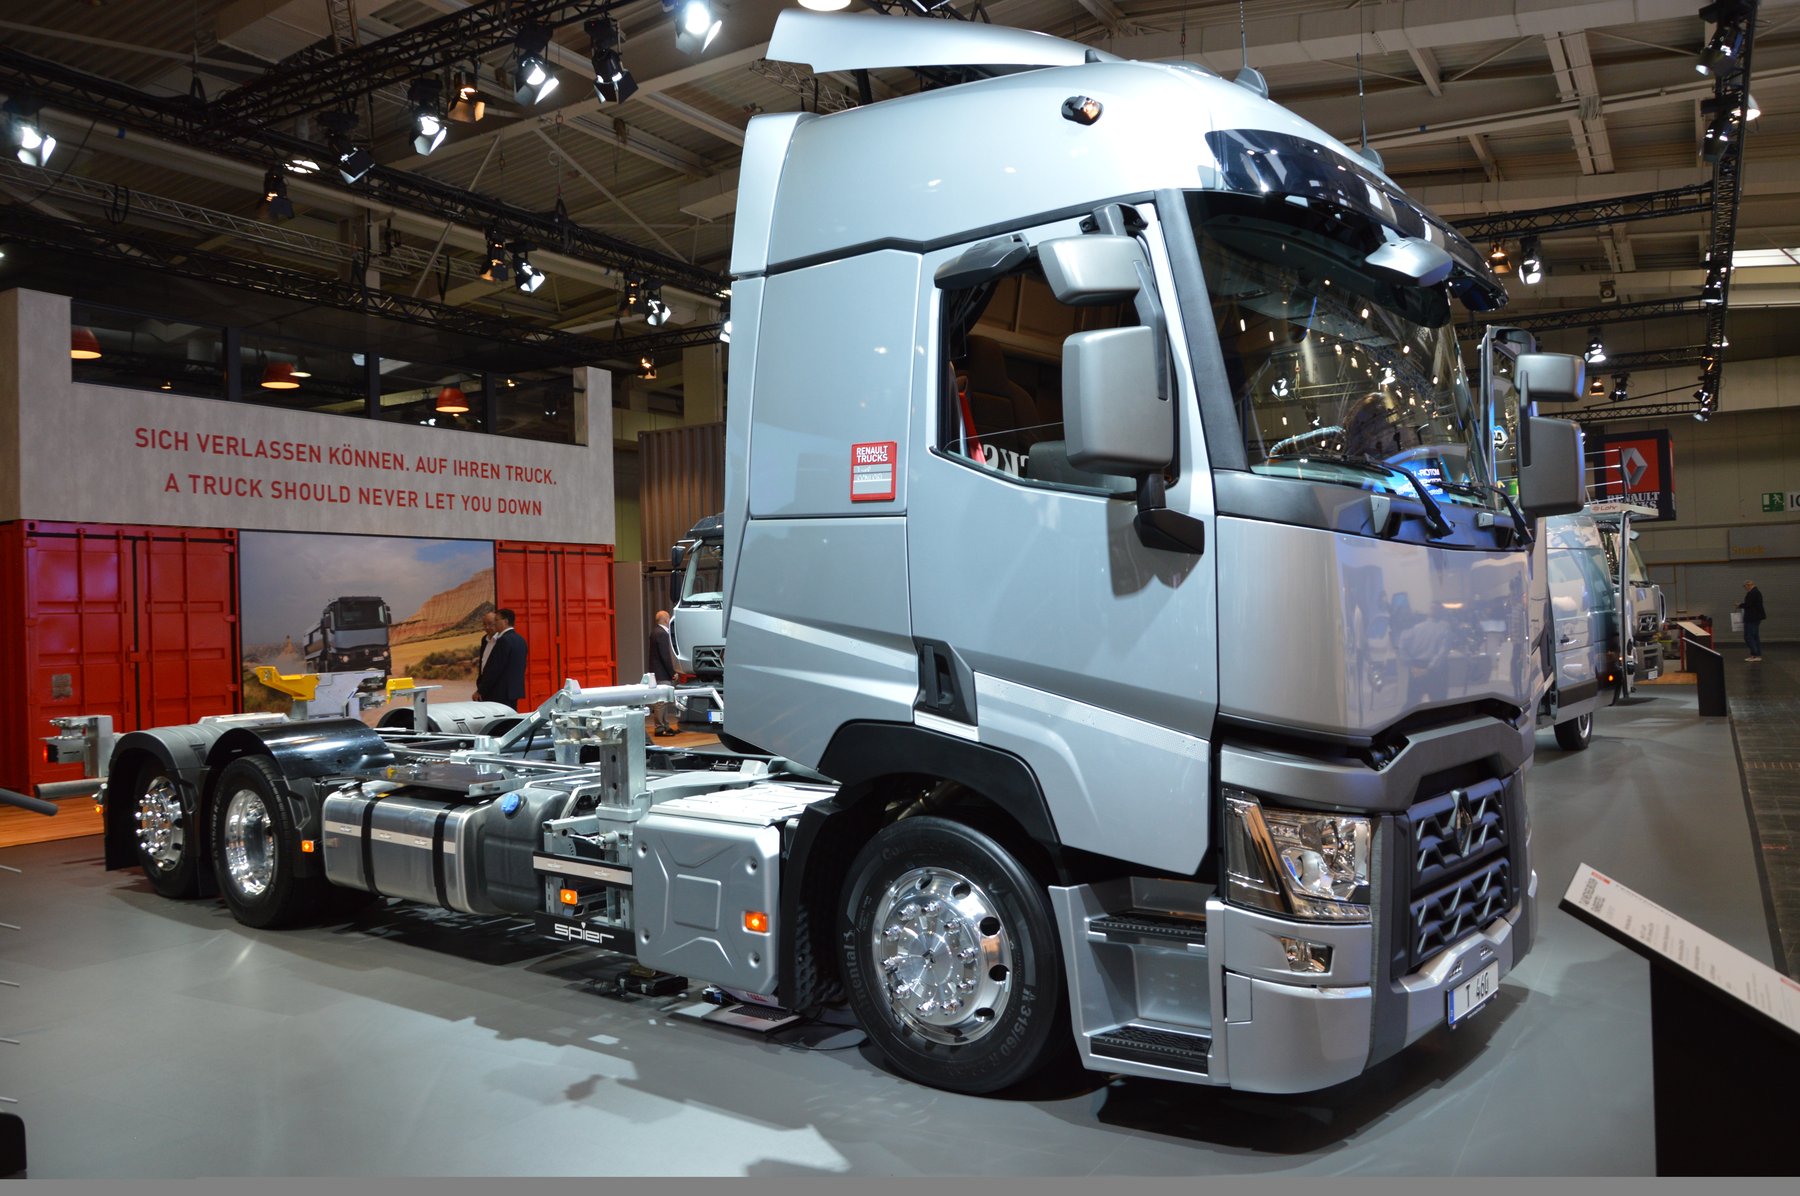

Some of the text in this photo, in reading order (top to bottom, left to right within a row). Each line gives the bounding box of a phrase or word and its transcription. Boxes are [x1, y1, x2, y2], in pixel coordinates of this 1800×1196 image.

[134, 426, 558, 486] SICH VERLASSEN KÖNNEN. AUF IHREN TRUCK.
[856, 445, 888, 455] RENAULT
[857, 453, 888, 463] TRUCKS
[164, 472, 544, 517] A TRUCK SHOULD NEVER LET YOU DOWN
[554, 921, 615, 944] spier
[1465, 983, 1470, 1008] T
